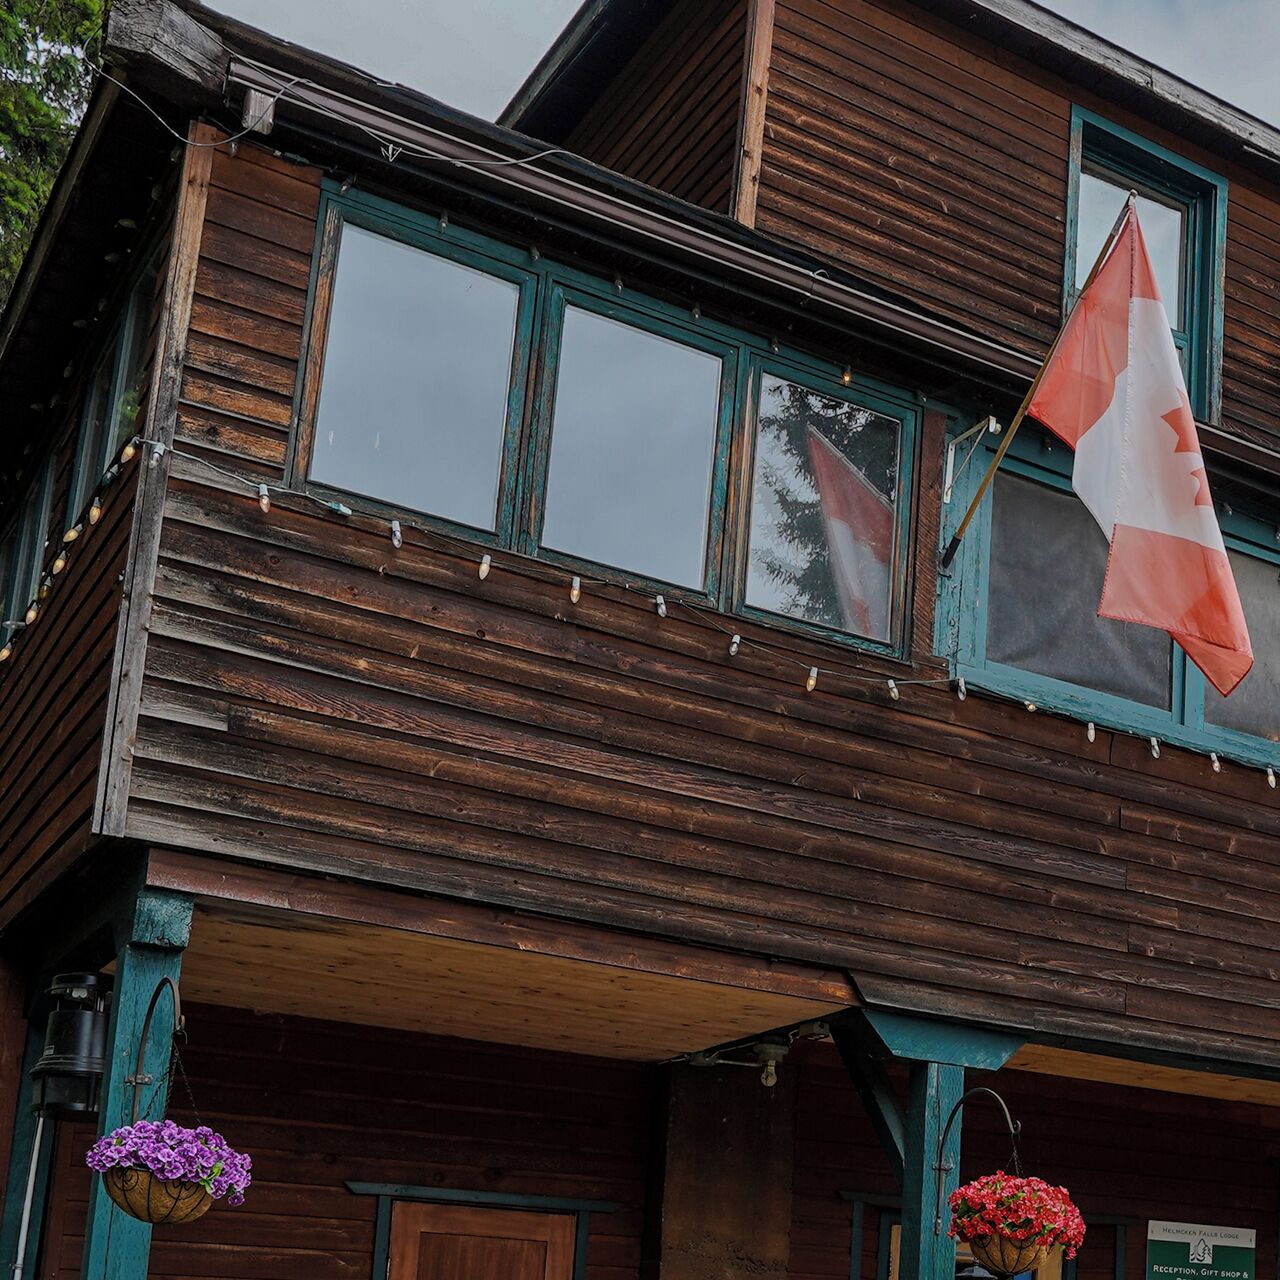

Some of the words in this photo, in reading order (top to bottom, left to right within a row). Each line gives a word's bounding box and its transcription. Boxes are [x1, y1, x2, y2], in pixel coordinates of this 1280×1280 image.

[1162, 1227, 1197, 1236] HELMCKEN
[1220, 1232, 1240, 1240] LODGE
[1153, 1264, 1199, 1276] RECEPTION,
[1200, 1268, 1219, 1277] GIFT
[1220, 1270, 1241, 1278] SHOP
[1242, 1271, 1249, 1279] &
